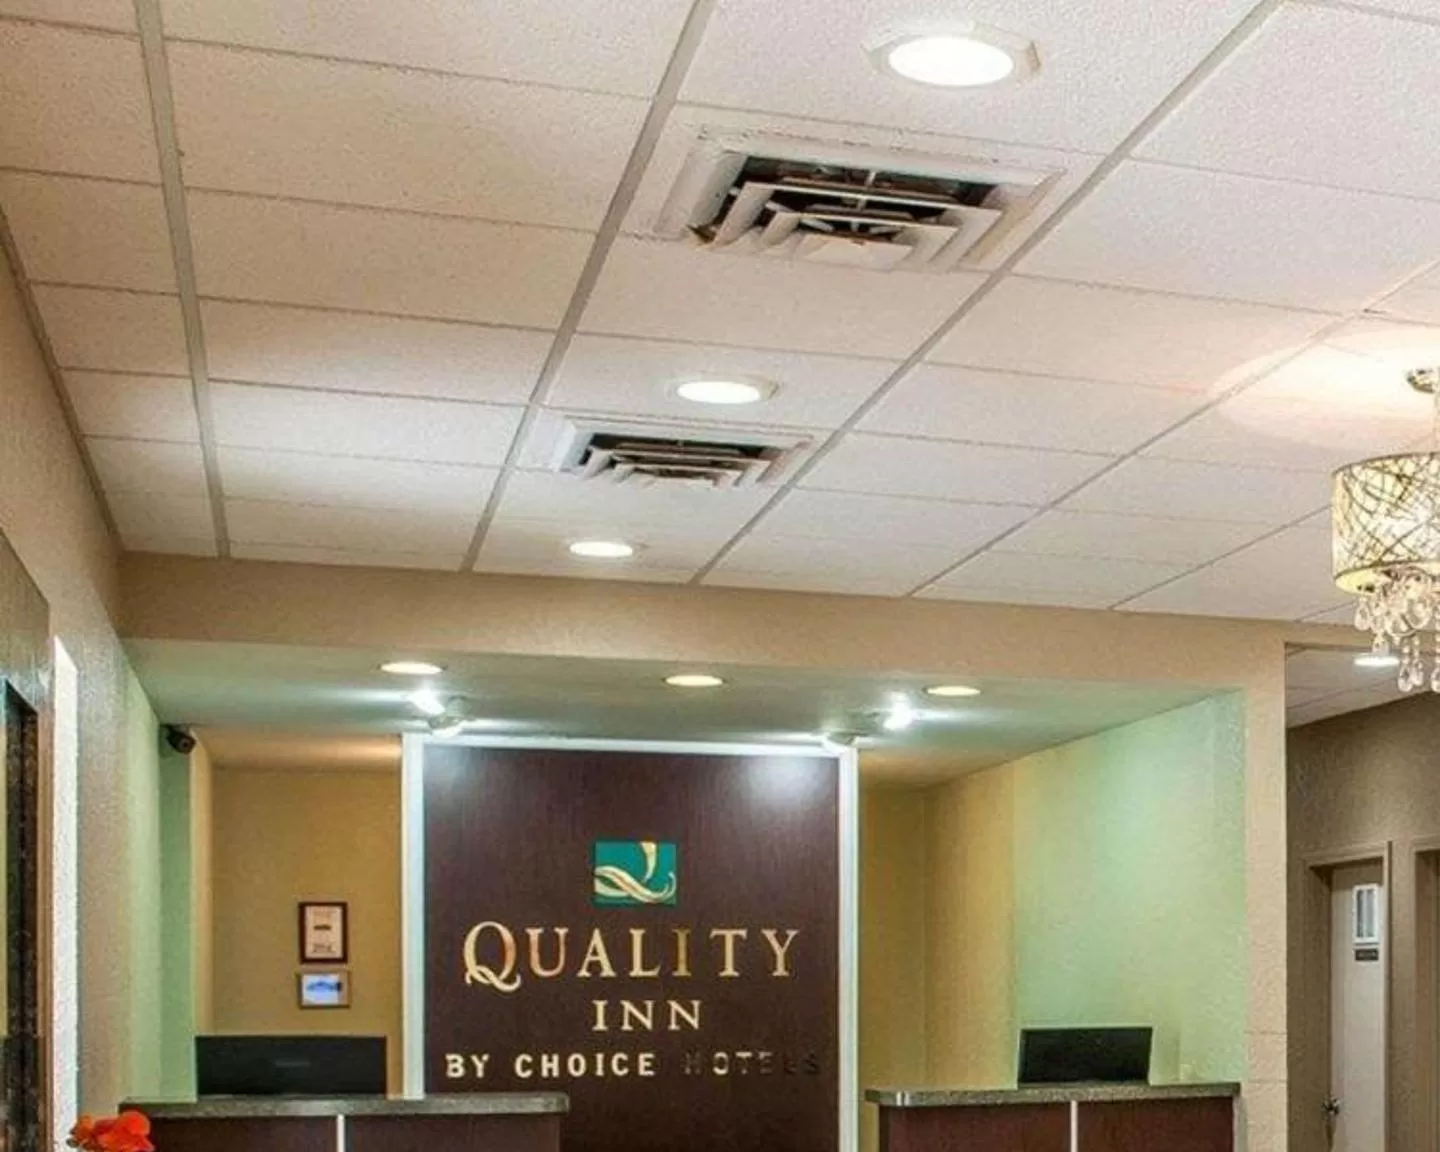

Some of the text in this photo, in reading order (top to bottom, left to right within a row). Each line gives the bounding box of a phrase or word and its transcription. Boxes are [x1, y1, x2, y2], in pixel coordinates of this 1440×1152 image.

[463, 920, 799, 992] QUALITY
[592, 1000, 701, 1031] INN
[445, 1053, 489, 1078] BY
[514, 1053, 655, 1078] CHOICE
